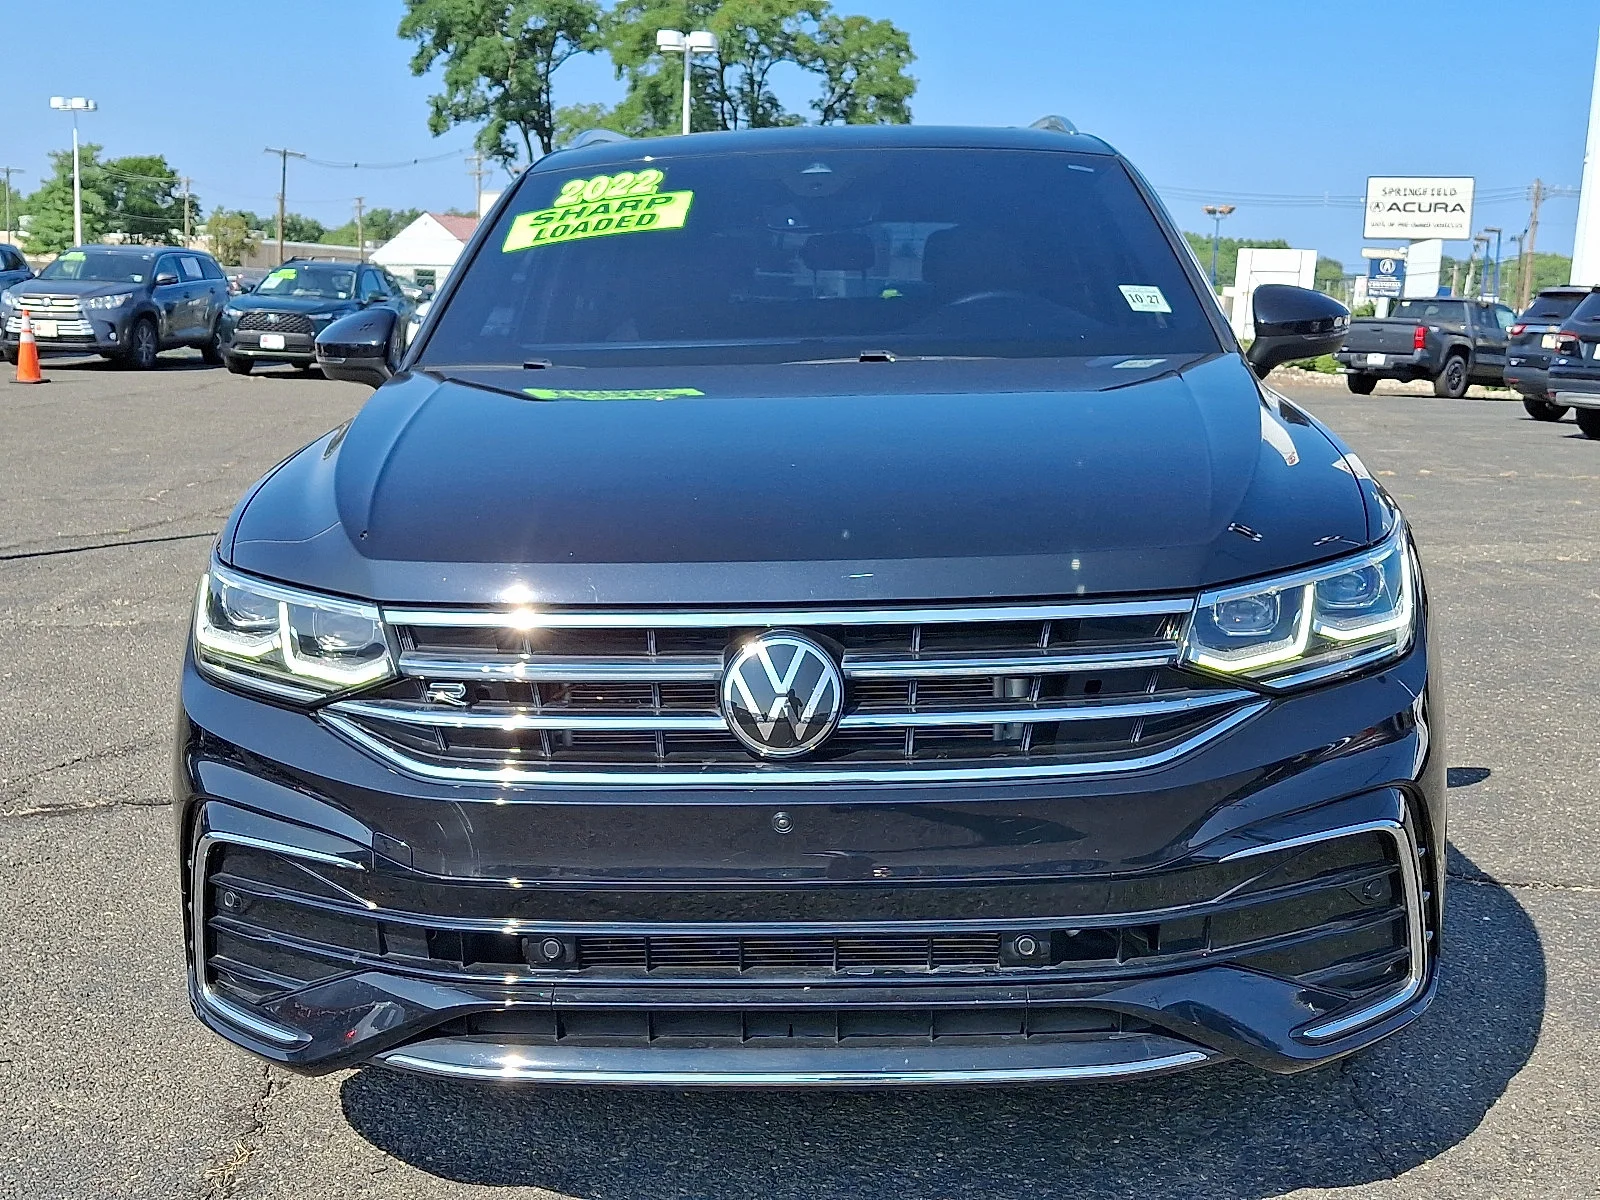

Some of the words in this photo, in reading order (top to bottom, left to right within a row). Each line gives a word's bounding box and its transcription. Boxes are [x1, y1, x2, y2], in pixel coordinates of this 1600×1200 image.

[553, 168, 664, 208] 2022
[1382, 187, 1457, 196] SPRINGFIELD
[529, 196, 673, 226] SHARP
[1386, 202, 1466, 213] ACURA
[532, 213, 657, 241] LOADED
[1128, 294, 1144, 303] 10
[1146, 295, 1160, 304] 27
